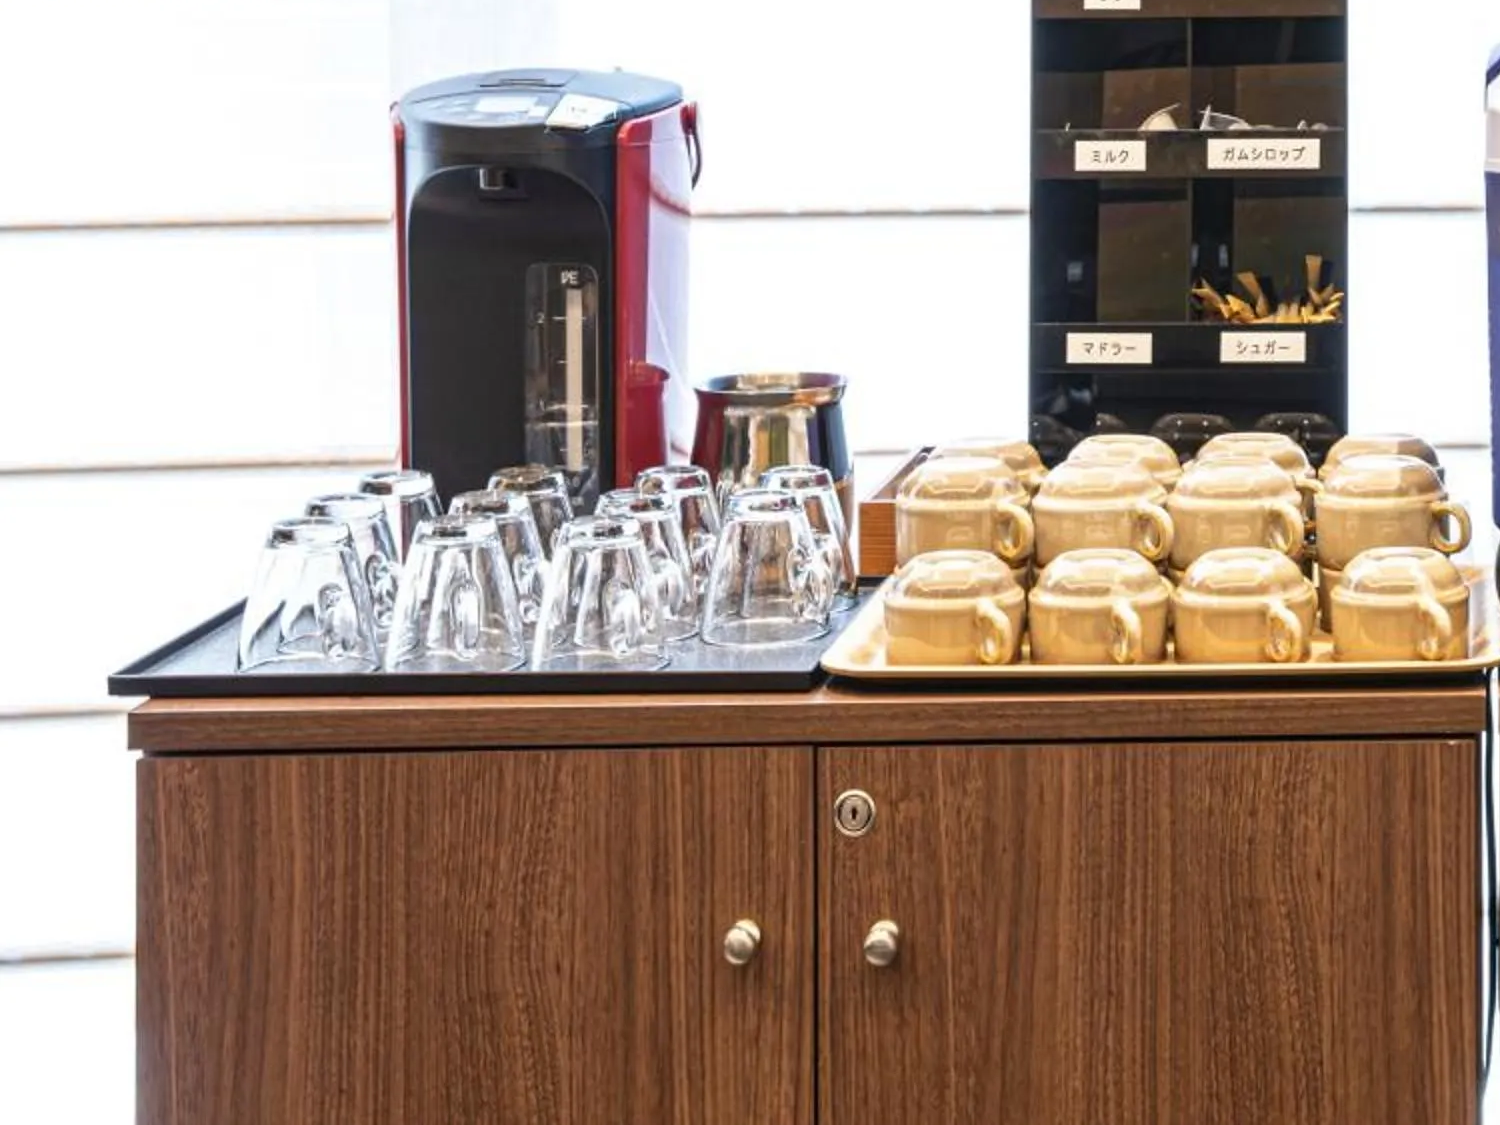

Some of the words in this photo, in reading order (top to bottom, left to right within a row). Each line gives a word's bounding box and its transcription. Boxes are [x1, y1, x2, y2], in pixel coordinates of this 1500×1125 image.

[1092, 149, 1129, 164] ミルク
[1223, 146, 1307, 162] ガムシロップ
[1083, 342, 1137, 356] マドラー
[1236, 339, 1291, 355] シュガー
